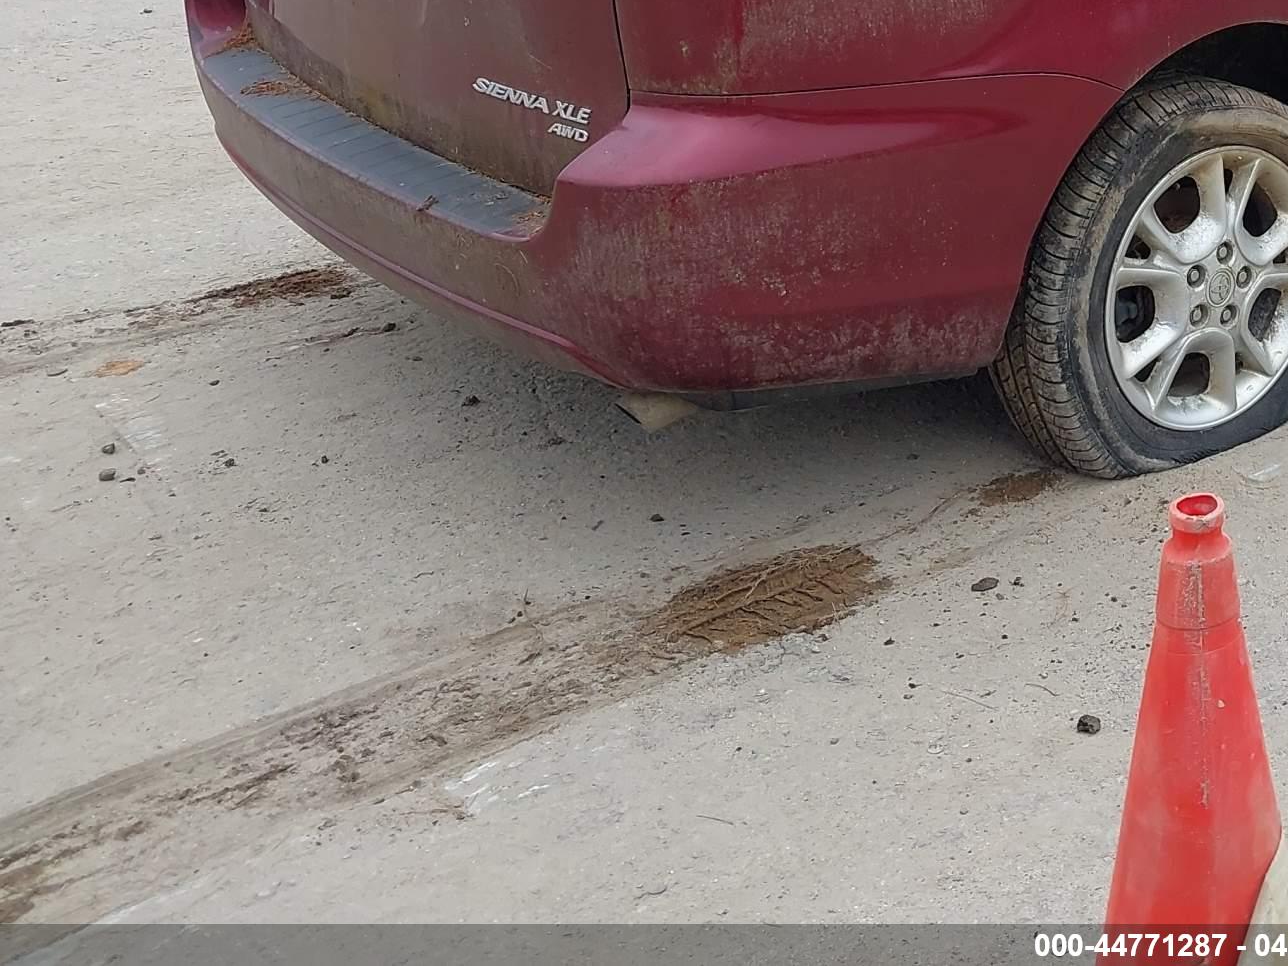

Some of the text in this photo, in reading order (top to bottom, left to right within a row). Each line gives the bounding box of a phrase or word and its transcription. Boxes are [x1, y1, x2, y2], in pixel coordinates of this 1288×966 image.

[472, 77, 592, 124] SIENNA XLE
[547, 122, 589, 143] AWD
